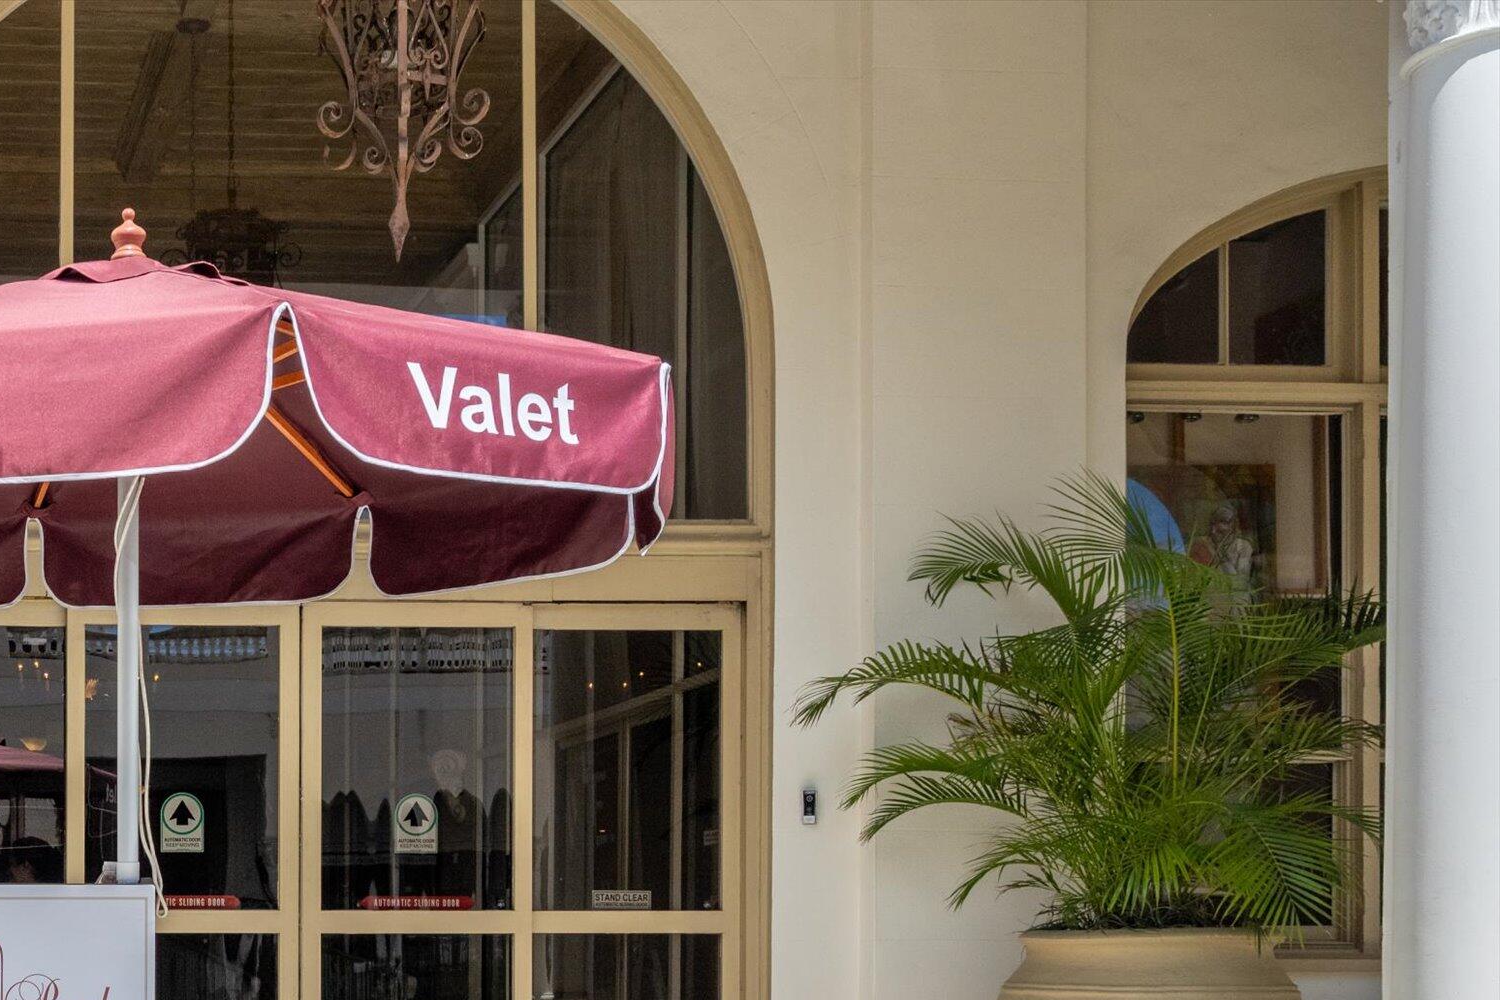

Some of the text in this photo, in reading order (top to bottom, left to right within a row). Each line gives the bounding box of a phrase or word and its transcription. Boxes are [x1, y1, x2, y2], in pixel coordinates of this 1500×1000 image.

[406, 362, 578, 445] Valet
[595, 893, 648, 901] STAND CLEAR
[179, 898, 205, 906] SLIDING
[207, 898, 226, 906] DOOR
[373, 899, 460, 907] AUTOMATIC SLIDING DOOR
